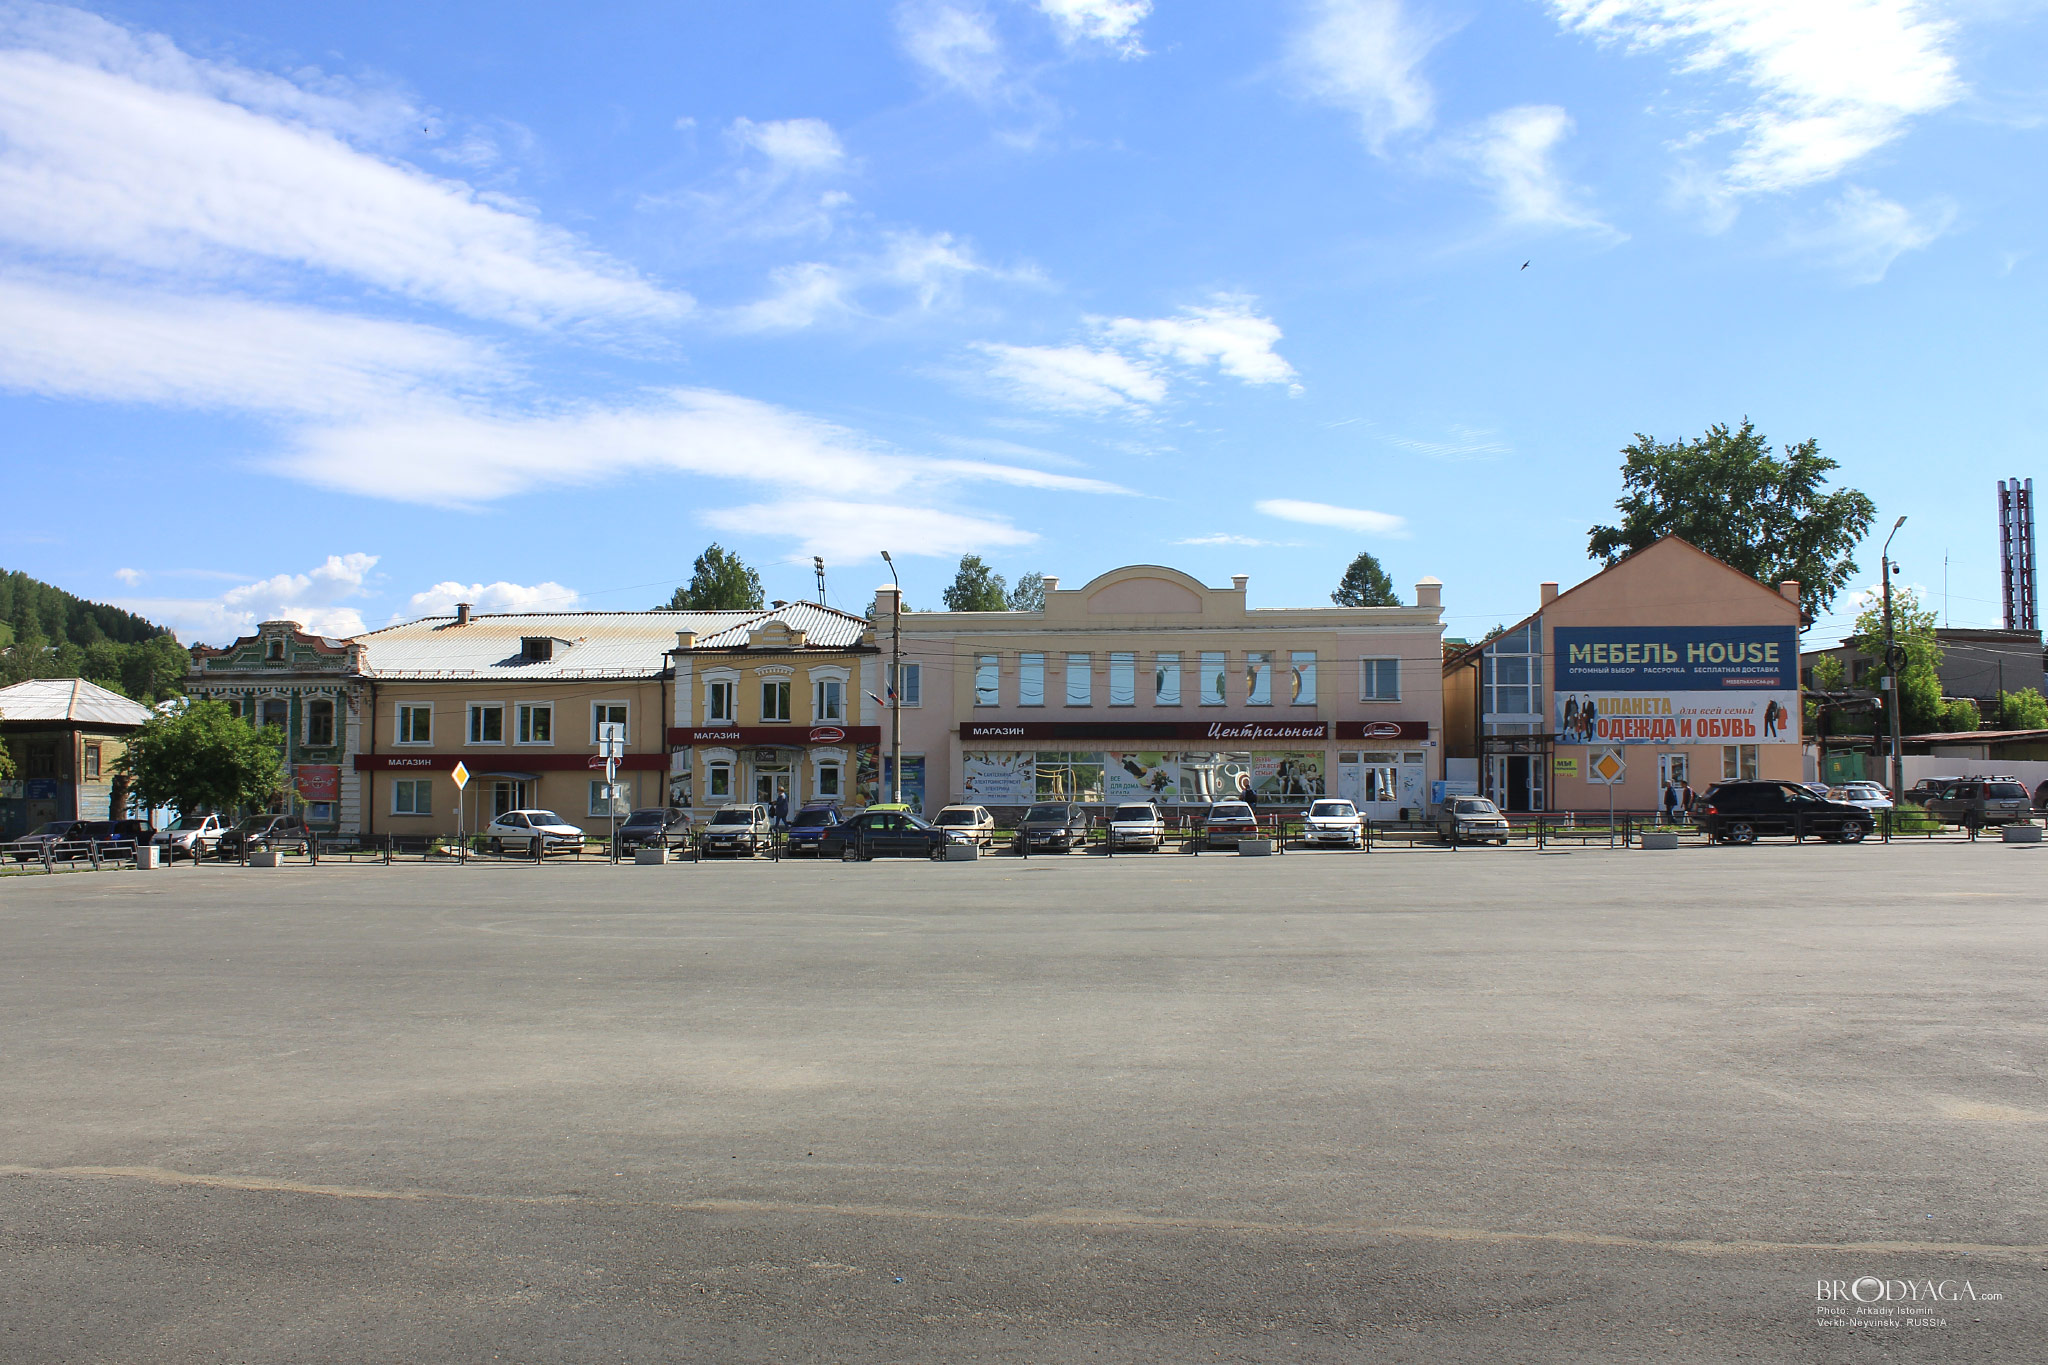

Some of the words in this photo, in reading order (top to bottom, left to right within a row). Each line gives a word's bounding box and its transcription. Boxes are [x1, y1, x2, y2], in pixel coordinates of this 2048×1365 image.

[1569, 643, 1678, 664] МЕБЕЛЬ
[1687, 642, 1780, 663] HOUSE
[1569, 666, 1609, 674] ОГРОМНЫЙ
[1742, 666, 1780, 674] ДОСТАВКА
[1598, 698, 1672, 715] ПЛАНЕТА
[1679, 707, 1697, 715] для
[1700, 705, 1722, 715] всей
[1724, 707, 1755, 715] семьи
[973, 727, 1024, 735] МАГАЗИН
[1207, 722, 1325, 740] Центральный
[1597, 718, 1676, 740] ОДЕЖДА
[1680, 718, 1692, 737] И
[1696, 718, 1756, 737] ОБУВЬ
[693, 732, 740, 740] МАГАЗИН
